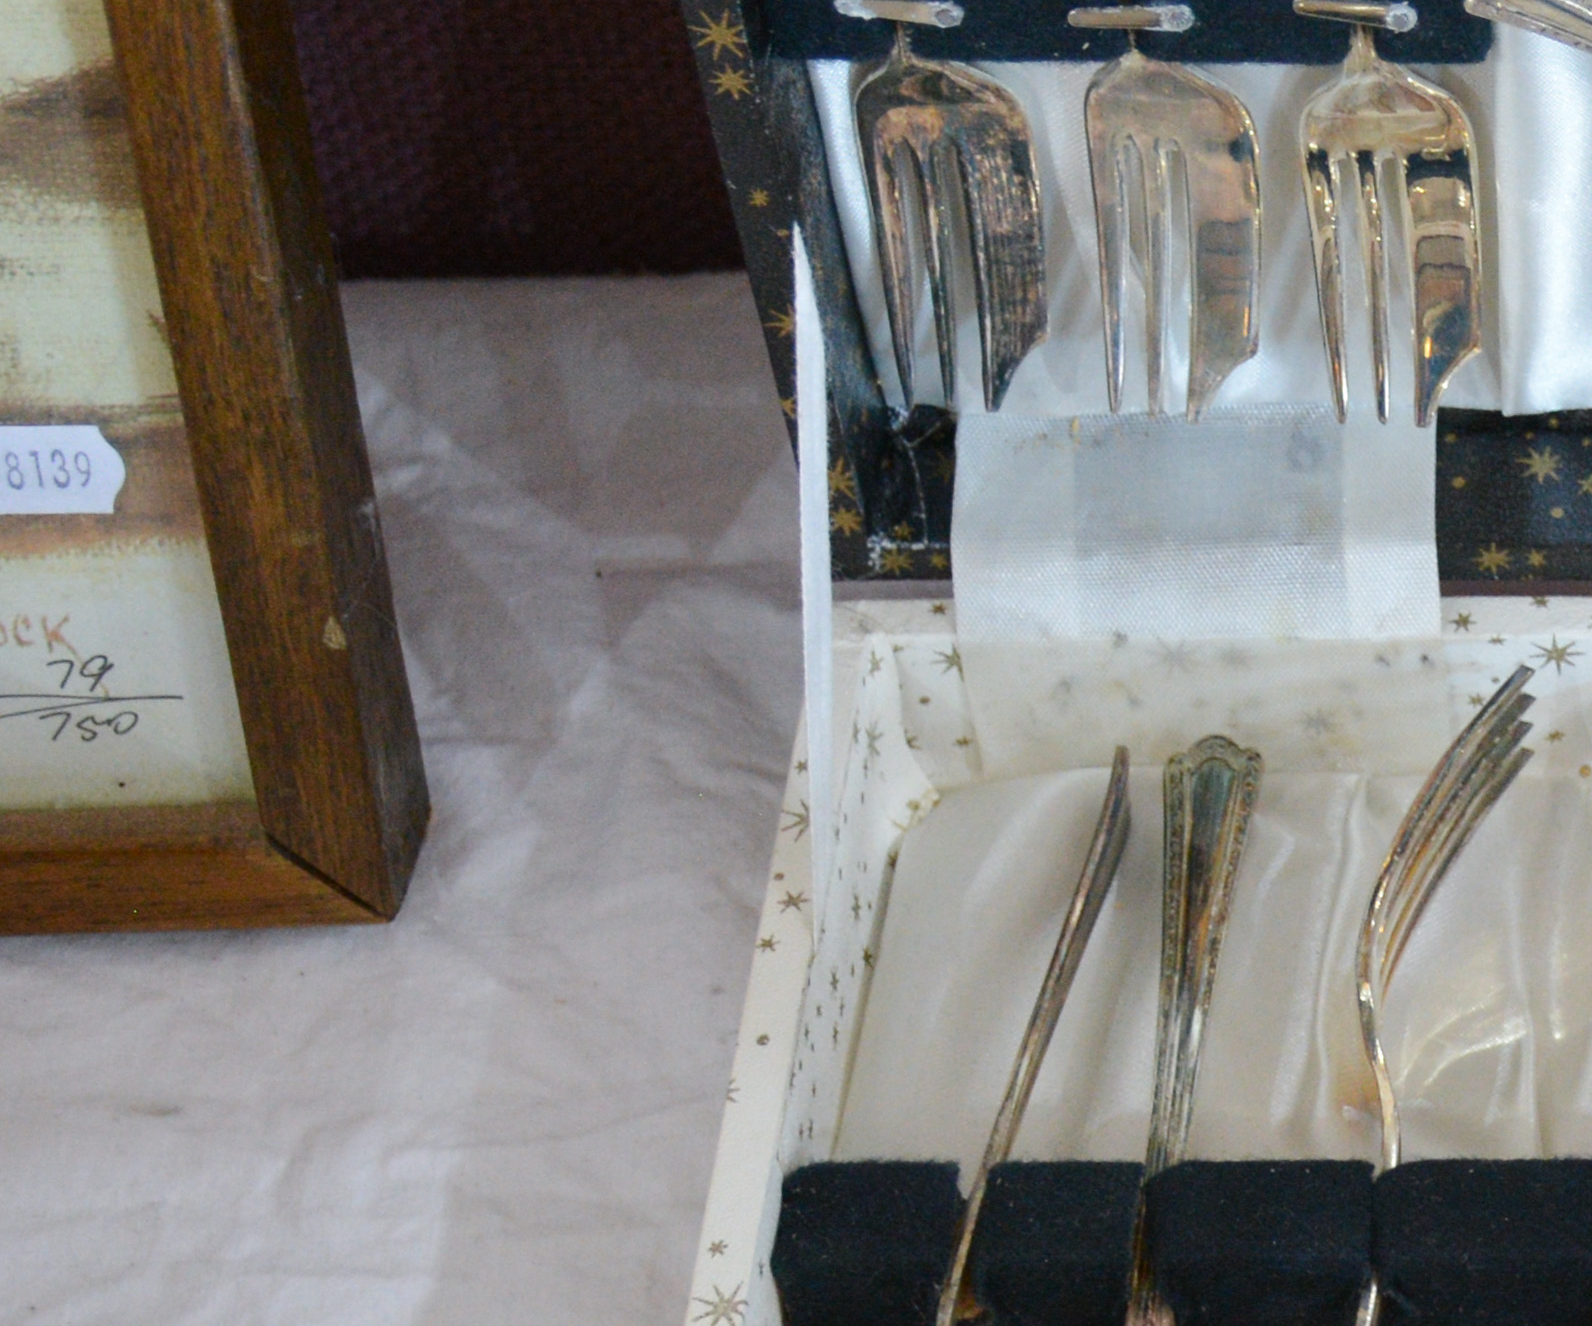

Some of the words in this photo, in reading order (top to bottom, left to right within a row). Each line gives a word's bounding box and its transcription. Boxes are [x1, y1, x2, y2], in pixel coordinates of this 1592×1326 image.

[4, 448, 91, 491] 8139
[46, 654, 115, 693] 79
[39, 710, 139, 742] 750
